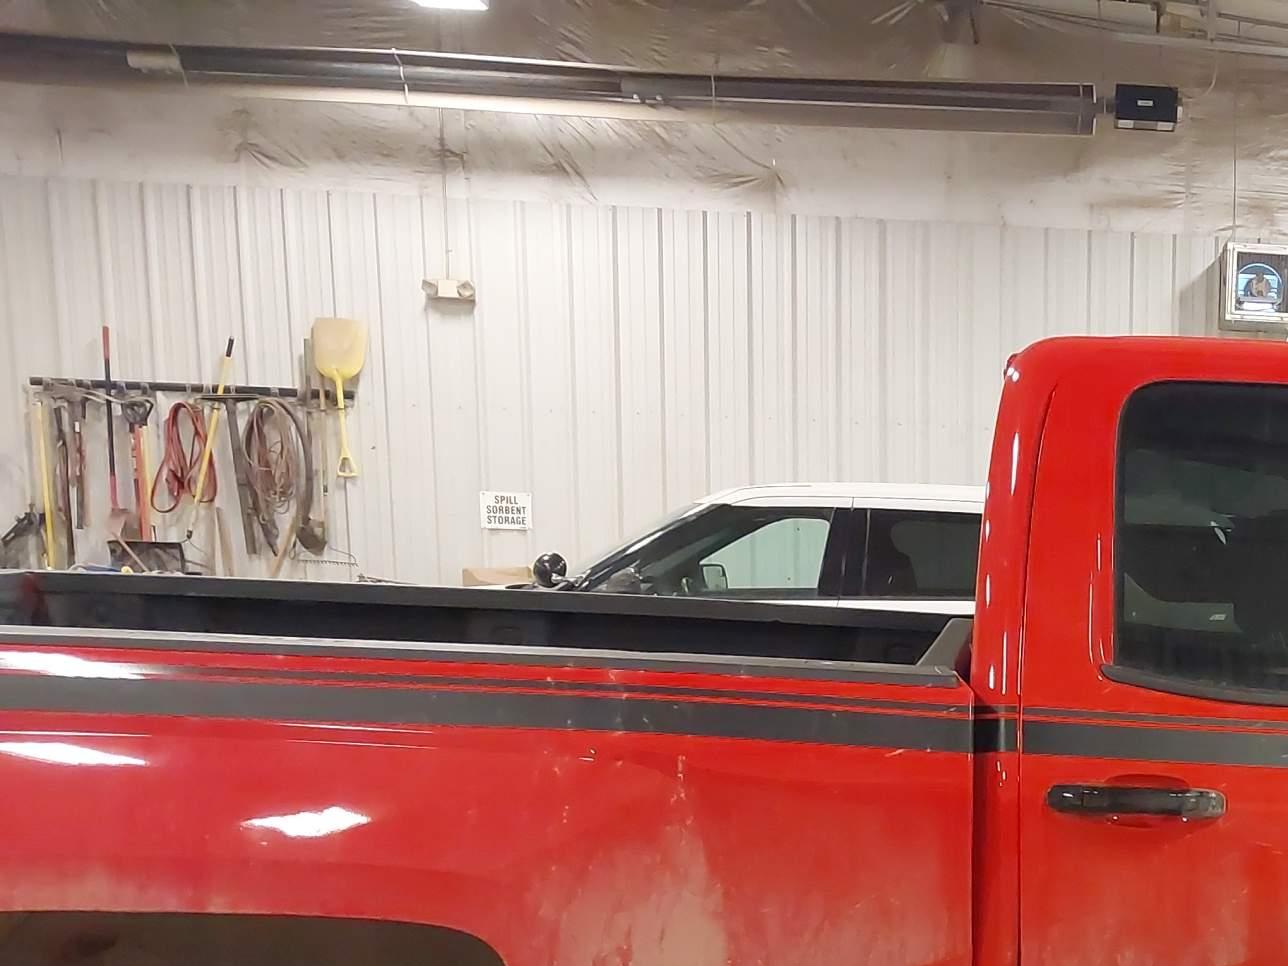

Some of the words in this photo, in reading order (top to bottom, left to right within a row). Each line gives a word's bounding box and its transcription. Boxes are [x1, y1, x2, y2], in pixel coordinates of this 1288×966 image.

[494, 495, 519, 505] SPILL
[486, 504, 527, 515] SORBENT
[486, 515, 527, 526] STORAGE
